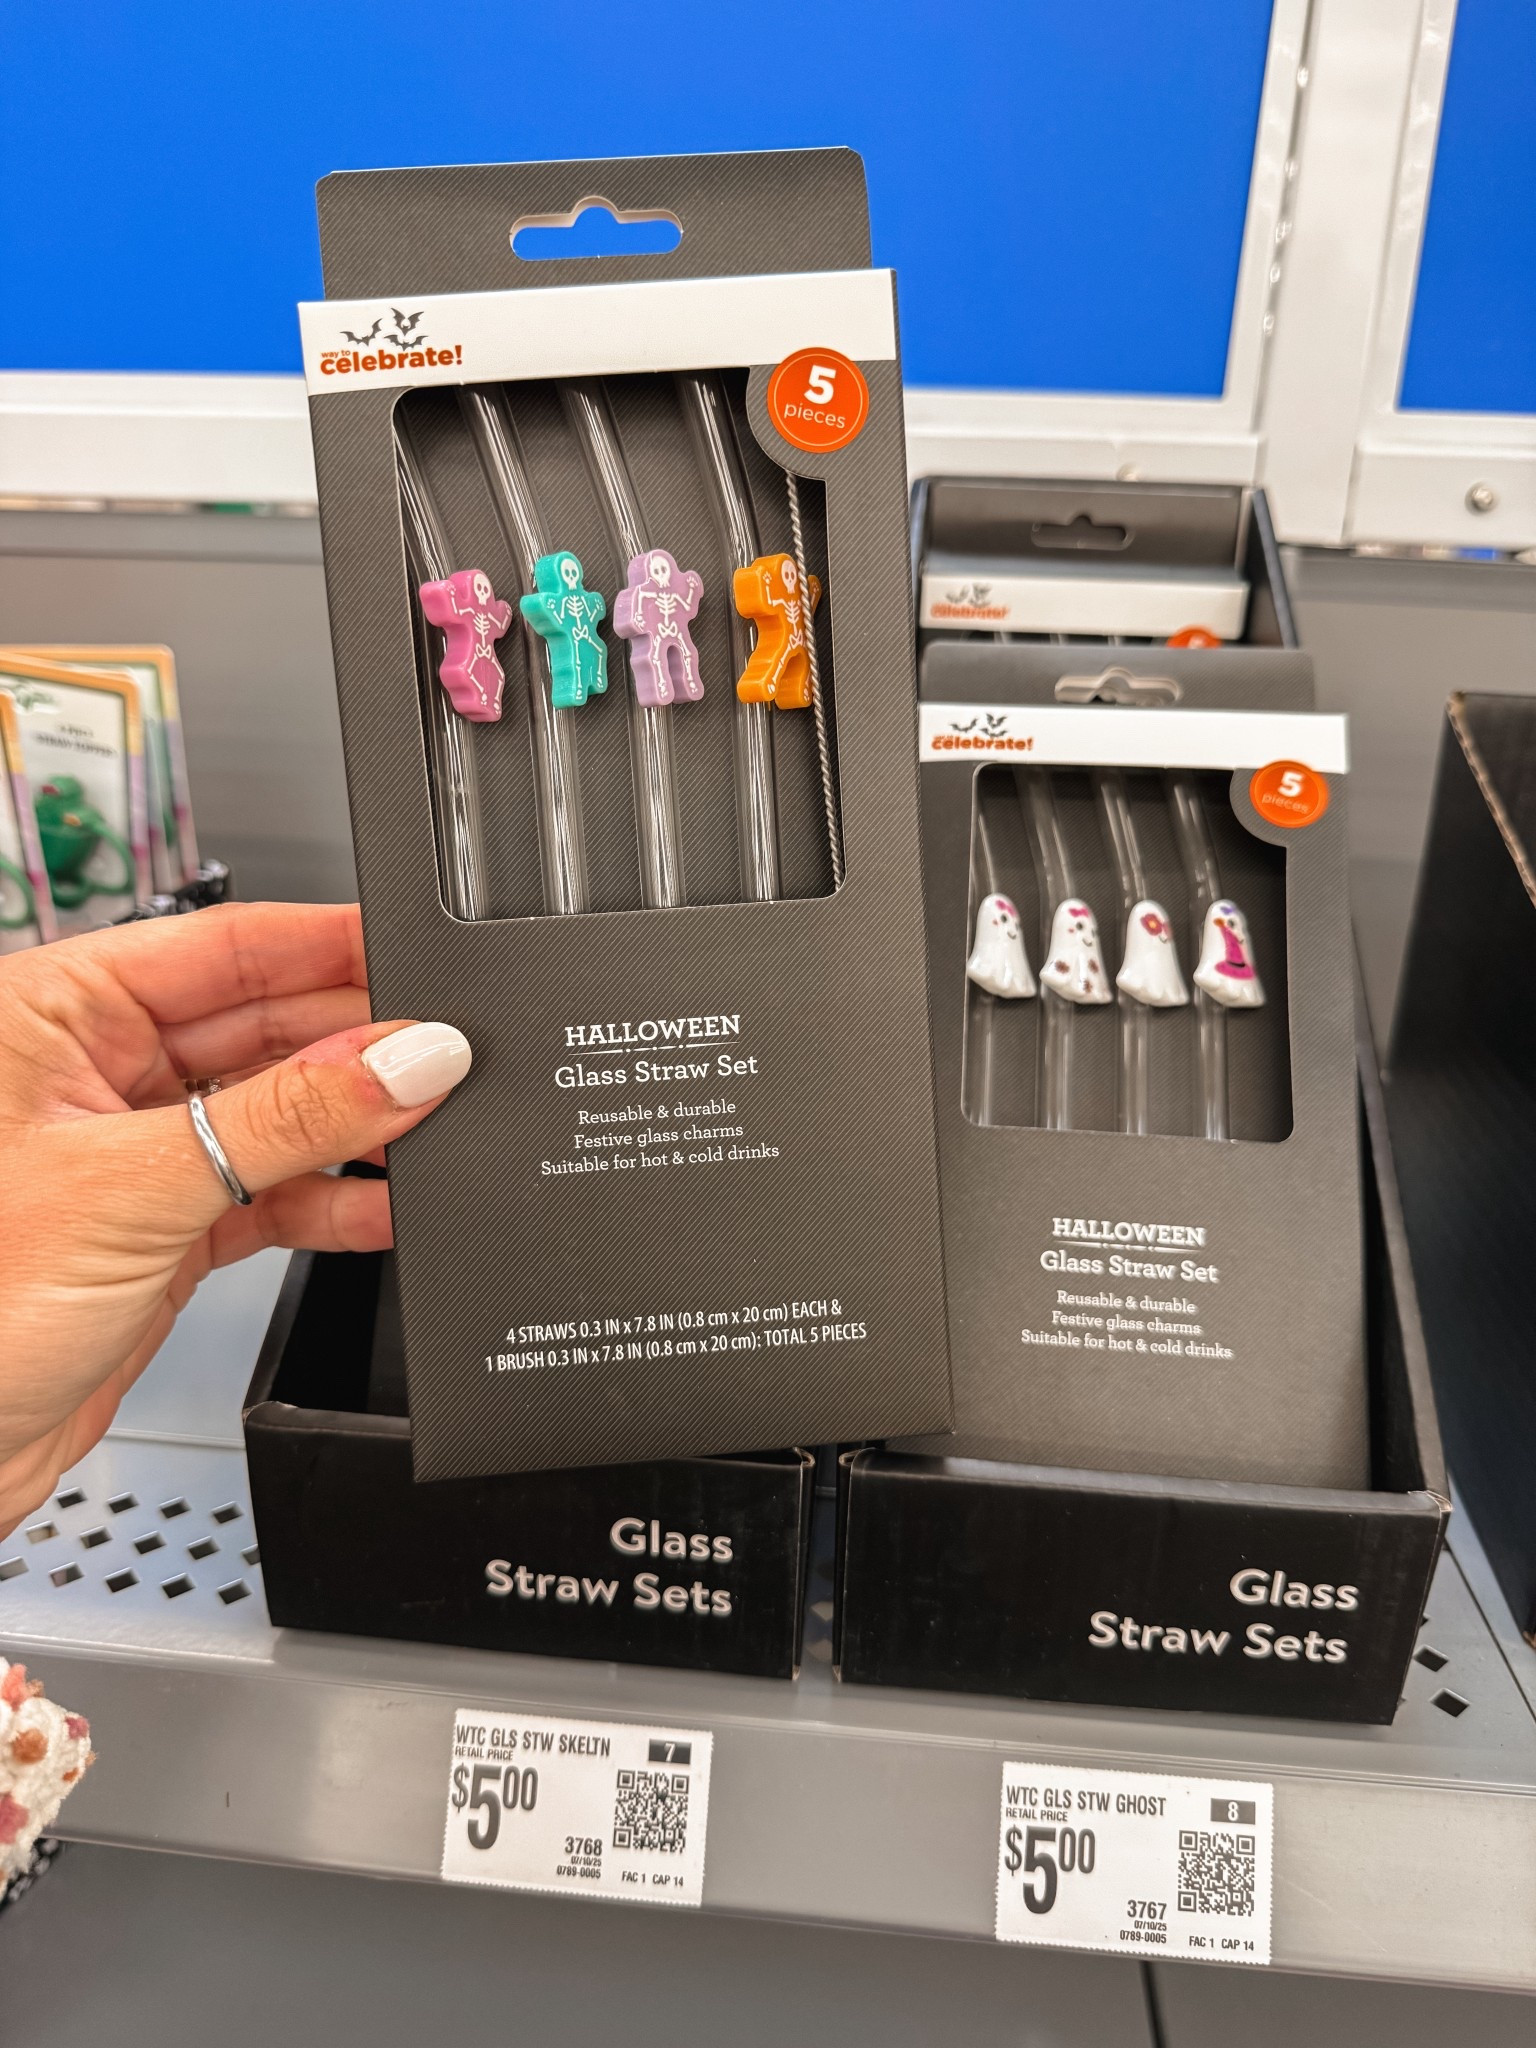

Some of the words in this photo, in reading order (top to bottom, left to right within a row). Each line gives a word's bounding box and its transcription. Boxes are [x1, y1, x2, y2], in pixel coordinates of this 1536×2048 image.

[320, 345, 463, 375] celebrate!
[321, 351, 339, 359] way
[804, 365, 837, 405] 5
[783, 402, 847, 431] pieces
[931, 735, 1034, 751] celebrate!
[1278, 770, 1305, 798] 5
[1261, 793, 1311, 816] pieces
[564, 1014, 741, 1047] HALLOWEEN
[554, 1064, 628, 1089] Glass
[635, 1060, 710, 1083] Straw
[717, 1054, 759, 1077] Set
[578, 1105, 653, 1125] Reusable
[656, 1106, 669, 1119] &
[673, 1098, 736, 1117] durable
[574, 1131, 633, 1149] Festive
[637, 1128, 679, 1147] glass
[683, 1124, 744, 1141] charms
[541, 1155, 609, 1176] Suitable
[613, 1153, 637, 1170] for
[641, 1151, 668, 1168] hot
[672, 1151, 685, 1164] &
[688, 1145, 723, 1163] cold
[727, 1142, 780, 1161] drinks
[1052, 1217, 1207, 1247] HALLOWEEN
[1040, 1250, 1104, 1274] Glass
[1108, 1254, 1175, 1280] Straw
[1180, 1259, 1220, 1283] Set
[1056, 1290, 1122, 1308] Reusable
[1125, 1296, 1137, 1309] &
[1139, 1295, 1198, 1314] durable
[506, 1327, 516, 1344] 4
[518, 1322, 577, 1343] STRAWS
[580, 1320, 602, 1338] 0.3
[605, 1318, 620, 1336] IN
[623, 1321, 632, 1334] x
[634, 1314, 657, 1333] 7.8
[659, 1313, 675, 1332] IN
[678, 1310, 705, 1331] (0.8
[707, 1311, 729, 1327] cm
[731, 1311, 740, 1324] x
[742, 1306, 760, 1324] 20
[762, 1303, 789, 1323] cm)
[792, 1300, 828, 1319] EACH
[831, 1298, 842, 1315] &
[1051, 1310, 1103, 1328] Festive
[1106, 1314, 1145, 1331] glass
[1146, 1317, 1203, 1336] charms
[485, 1354, 493, 1372] 1
[496, 1351, 545, 1371] BRUSH
[547, 1348, 570, 1367] 0.3
[573, 1346, 588, 1365] IN
[591, 1349, 600, 1363] x
[602, 1343, 625, 1362] 7.8
[627, 1341, 642, 1360] IN
[646, 1339, 673, 1360] (0.8
[675, 1340, 697, 1356] cm
[699, 1340, 708, 1353] x
[710, 1334, 728, 1353] 20
[730, 1331, 762, 1351] cm):
[764, 1327, 808, 1347] TOTAL
[810, 1325, 819, 1343] 5
[822, 1322, 867, 1342] PIECES
[1021, 1328, 1081, 1347] Suitable
[1083, 1332, 1105, 1349] for
[1107, 1335, 1133, 1351] hot
[1135, 1339, 1147, 1353] &
[1149, 1339, 1181, 1356] cold
[1185, 1341, 1234, 1359] drinks
[610, 1516, 733, 1563] Glass
[485, 1558, 619, 1607] Straw
[633, 1572, 733, 1617] Sets
[1229, 1567, 1359, 1611] Glass
[1088, 1610, 1231, 1656] Straw
[1242, 1622, 1349, 1664] Sets
[455, 1746, 485, 1759] RETAIL
[487, 1748, 513, 1761] PRICE
[456, 1724, 486, 1746] WTC
[491, 1727, 518, 1749] GLS
[523, 1730, 555, 1751] STW
[559, 1734, 611, 1757] SKELTN
[664, 1743, 675, 1762] 7
[1006, 1785, 1038, 1806] WTC
[1044, 1788, 1072, 1809] GLS
[1077, 1791, 1110, 1812] STW
[1116, 1794, 1167, 1816] GHOST
[1227, 1801, 1238, 1821] 8
[1005, 1807, 1037, 1820] RETAIL
[1040, 1809, 1068, 1822] PRICE
[565, 1836, 603, 1856] 3768
[556, 1865, 601, 1879] 0789-0005
[621, 1870, 639, 1883] FAC
[652, 1873, 671, 1886] CAP
[674, 1875, 684, 1887] 14
[1127, 1900, 1167, 1920] 3767
[1119, 1929, 1167, 1944] 0789-0005
[1134, 1919, 1167, 1931] 07/10/25
[1189, 1935, 1206, 1948] FAC
[1221, 1938, 1240, 1951] CAP
[1243, 1940, 1254, 1951] 14
